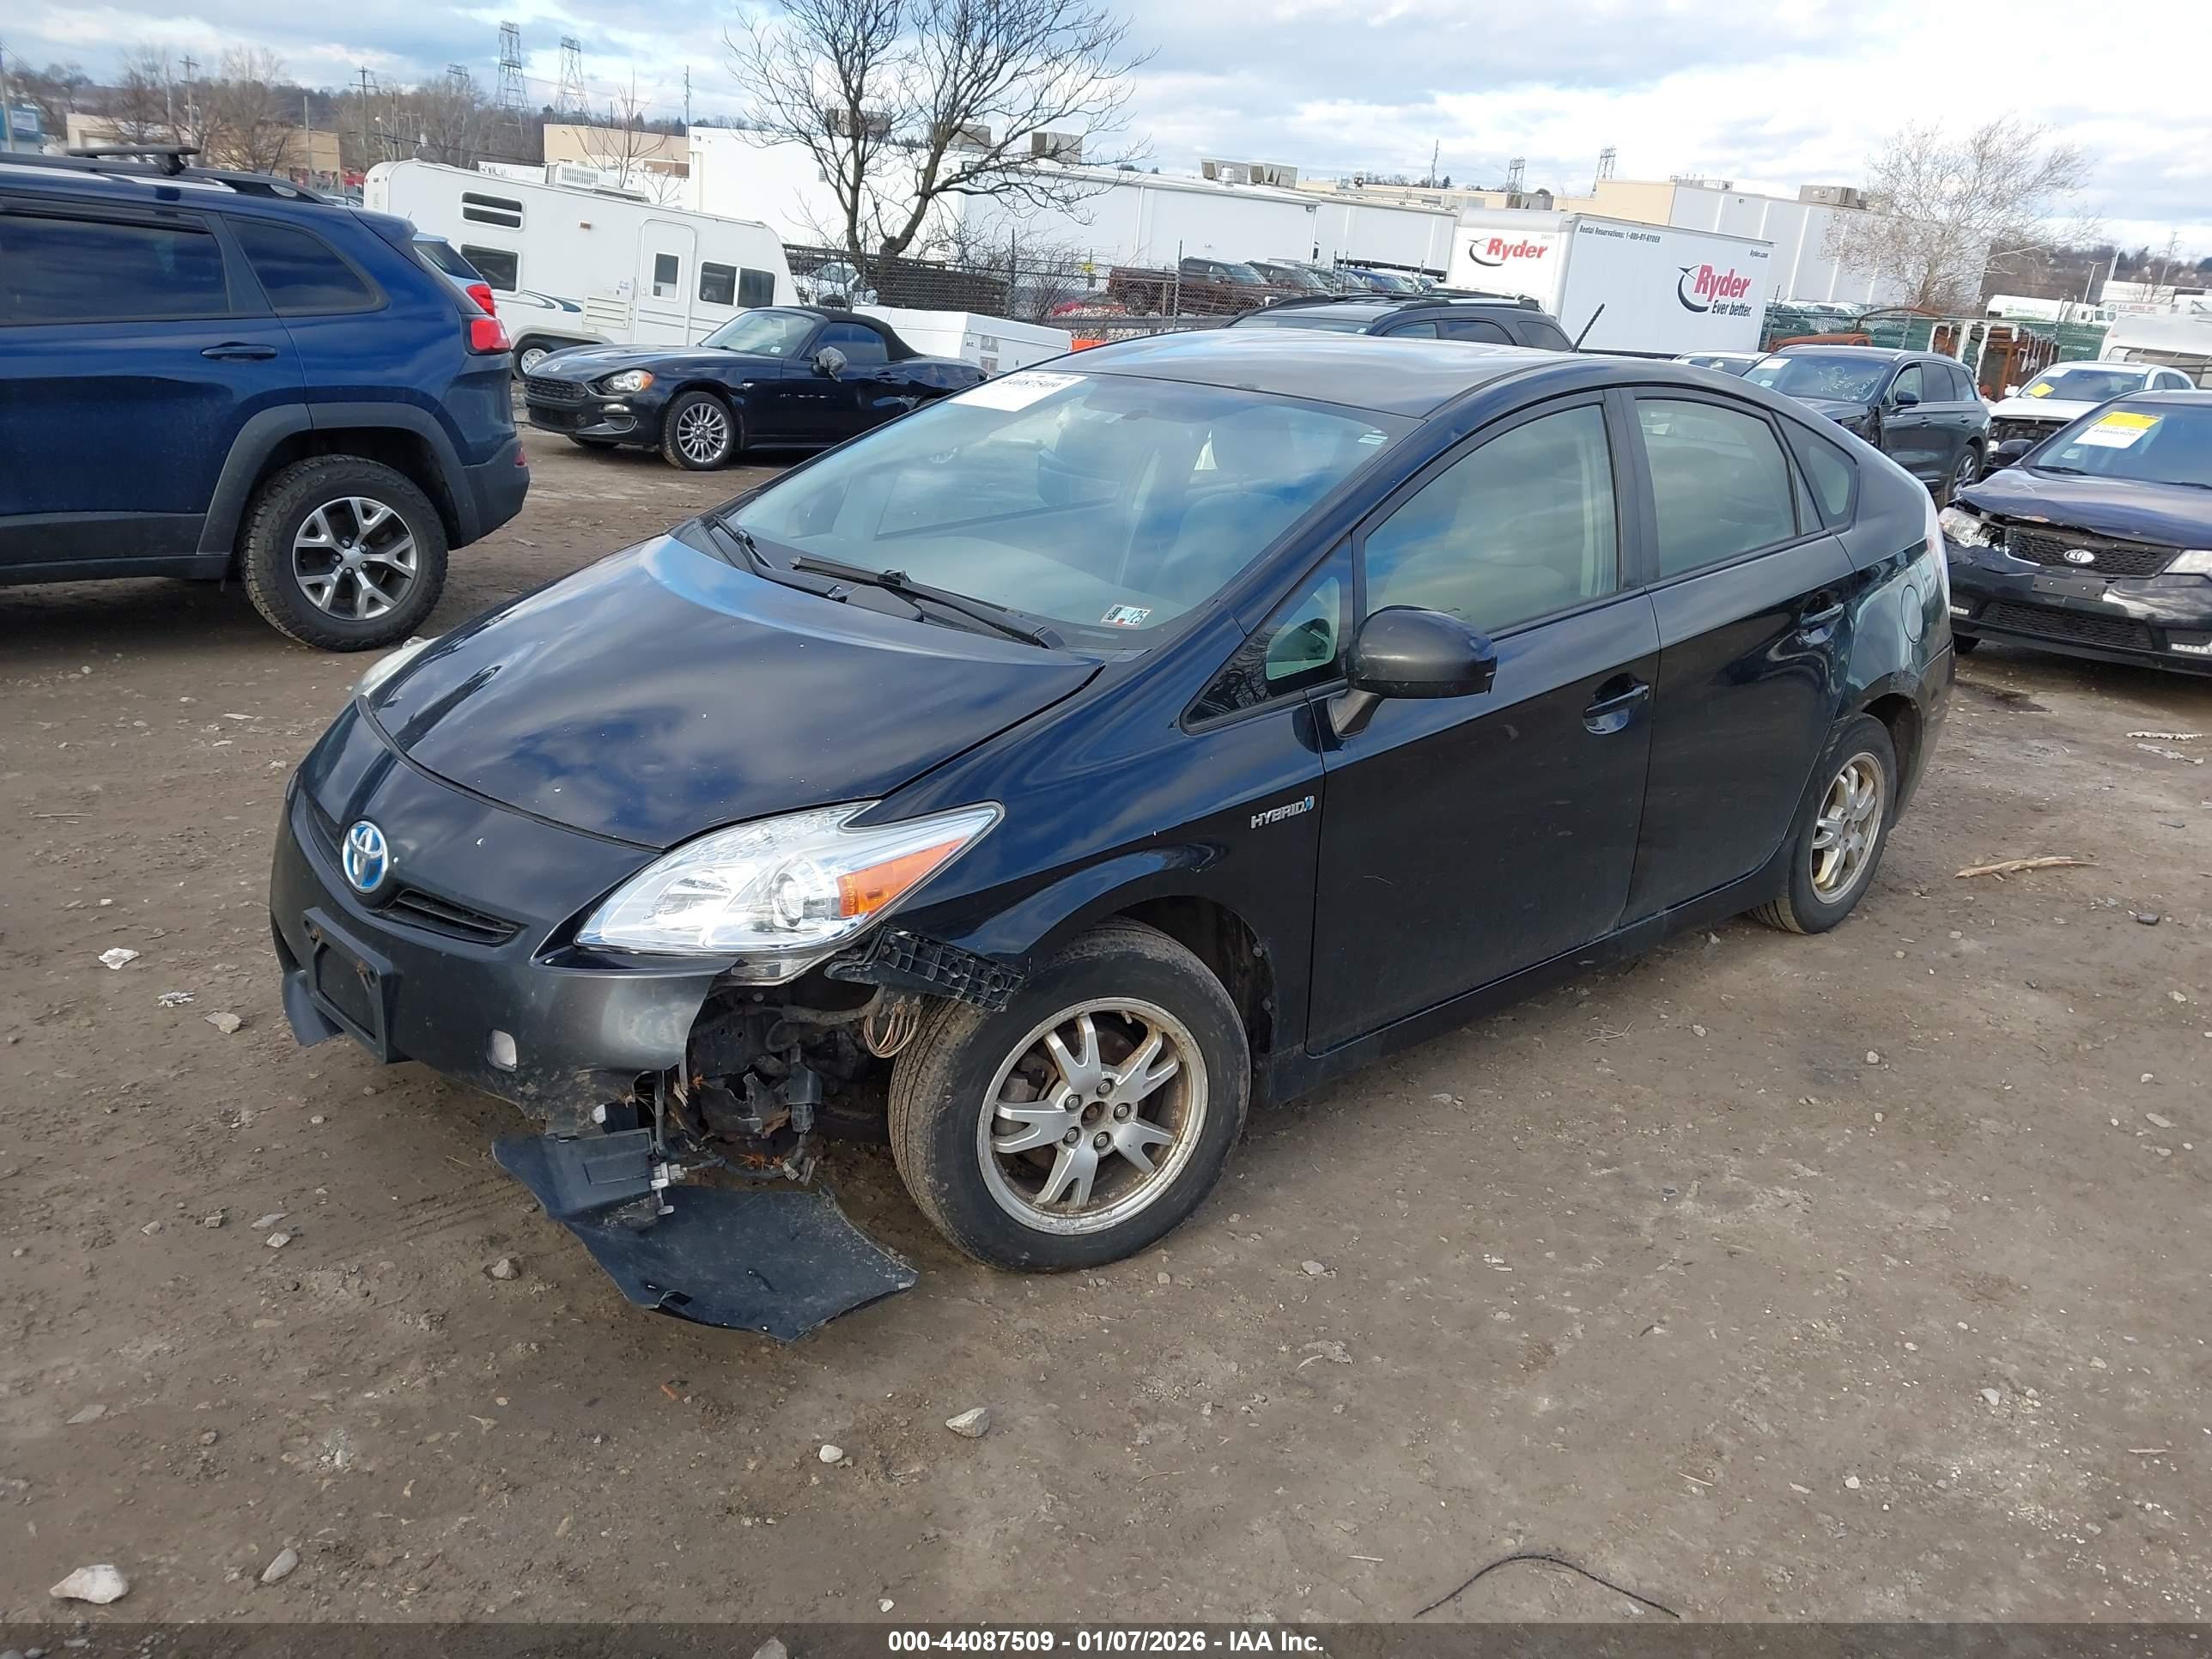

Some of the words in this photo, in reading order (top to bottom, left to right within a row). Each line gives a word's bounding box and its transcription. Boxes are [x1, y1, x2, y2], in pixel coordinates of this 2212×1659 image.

[1579, 224, 1595, 234] Rental
[1486, 238, 1549, 261] Ryder
[1693, 264, 1752, 302] Ryder
[1711, 300, 1729, 315] Ever
[1729, 301, 1753, 317] better.
[1250, 800, 1306, 830] HYBRID
